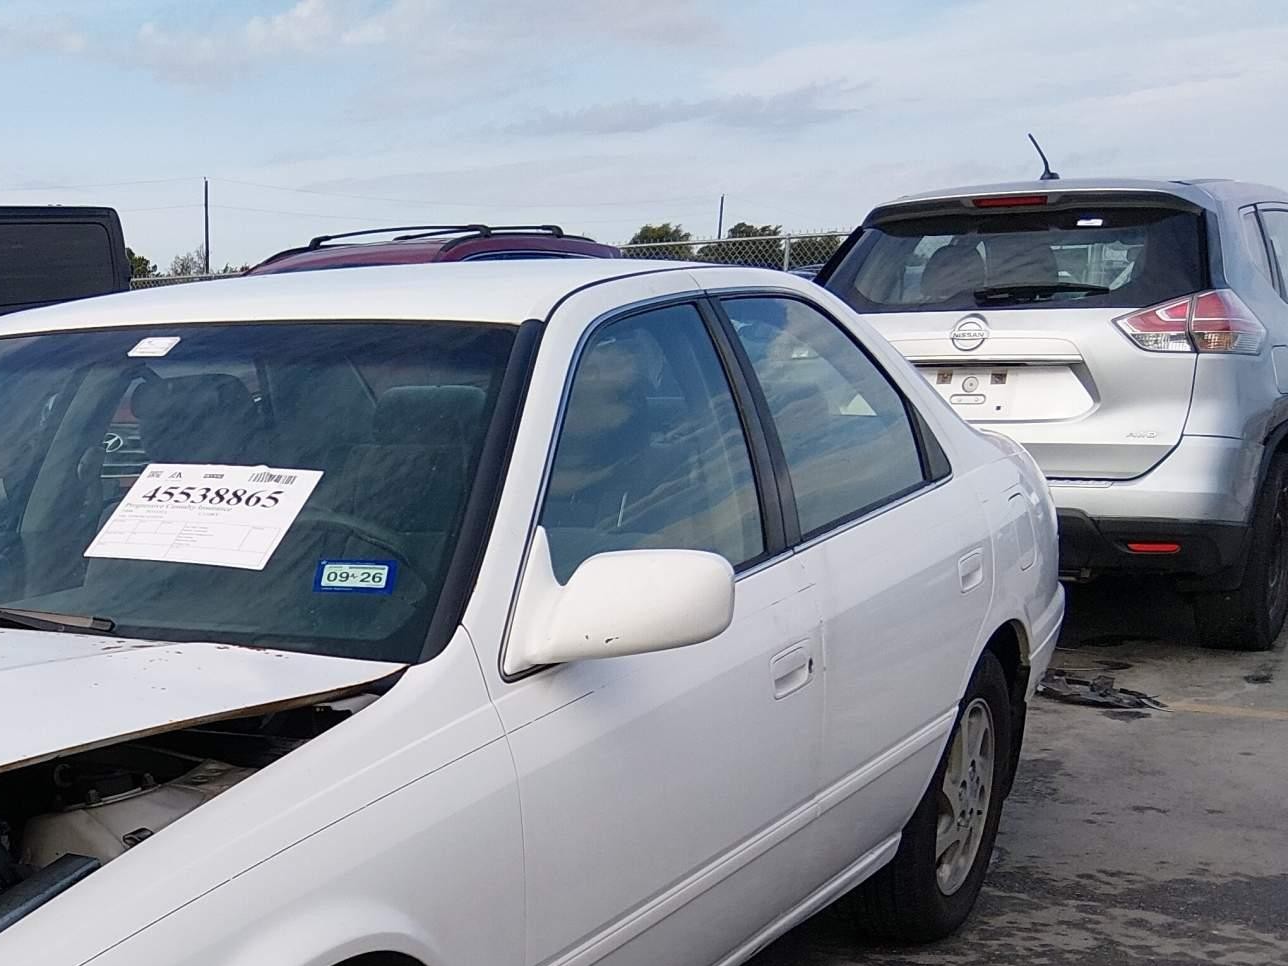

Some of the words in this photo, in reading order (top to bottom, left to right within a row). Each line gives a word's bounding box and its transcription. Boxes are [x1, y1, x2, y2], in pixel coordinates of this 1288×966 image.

[141, 485, 286, 509] 45538865
[326, 571, 350, 583] 09
[359, 571, 385, 584] 26
